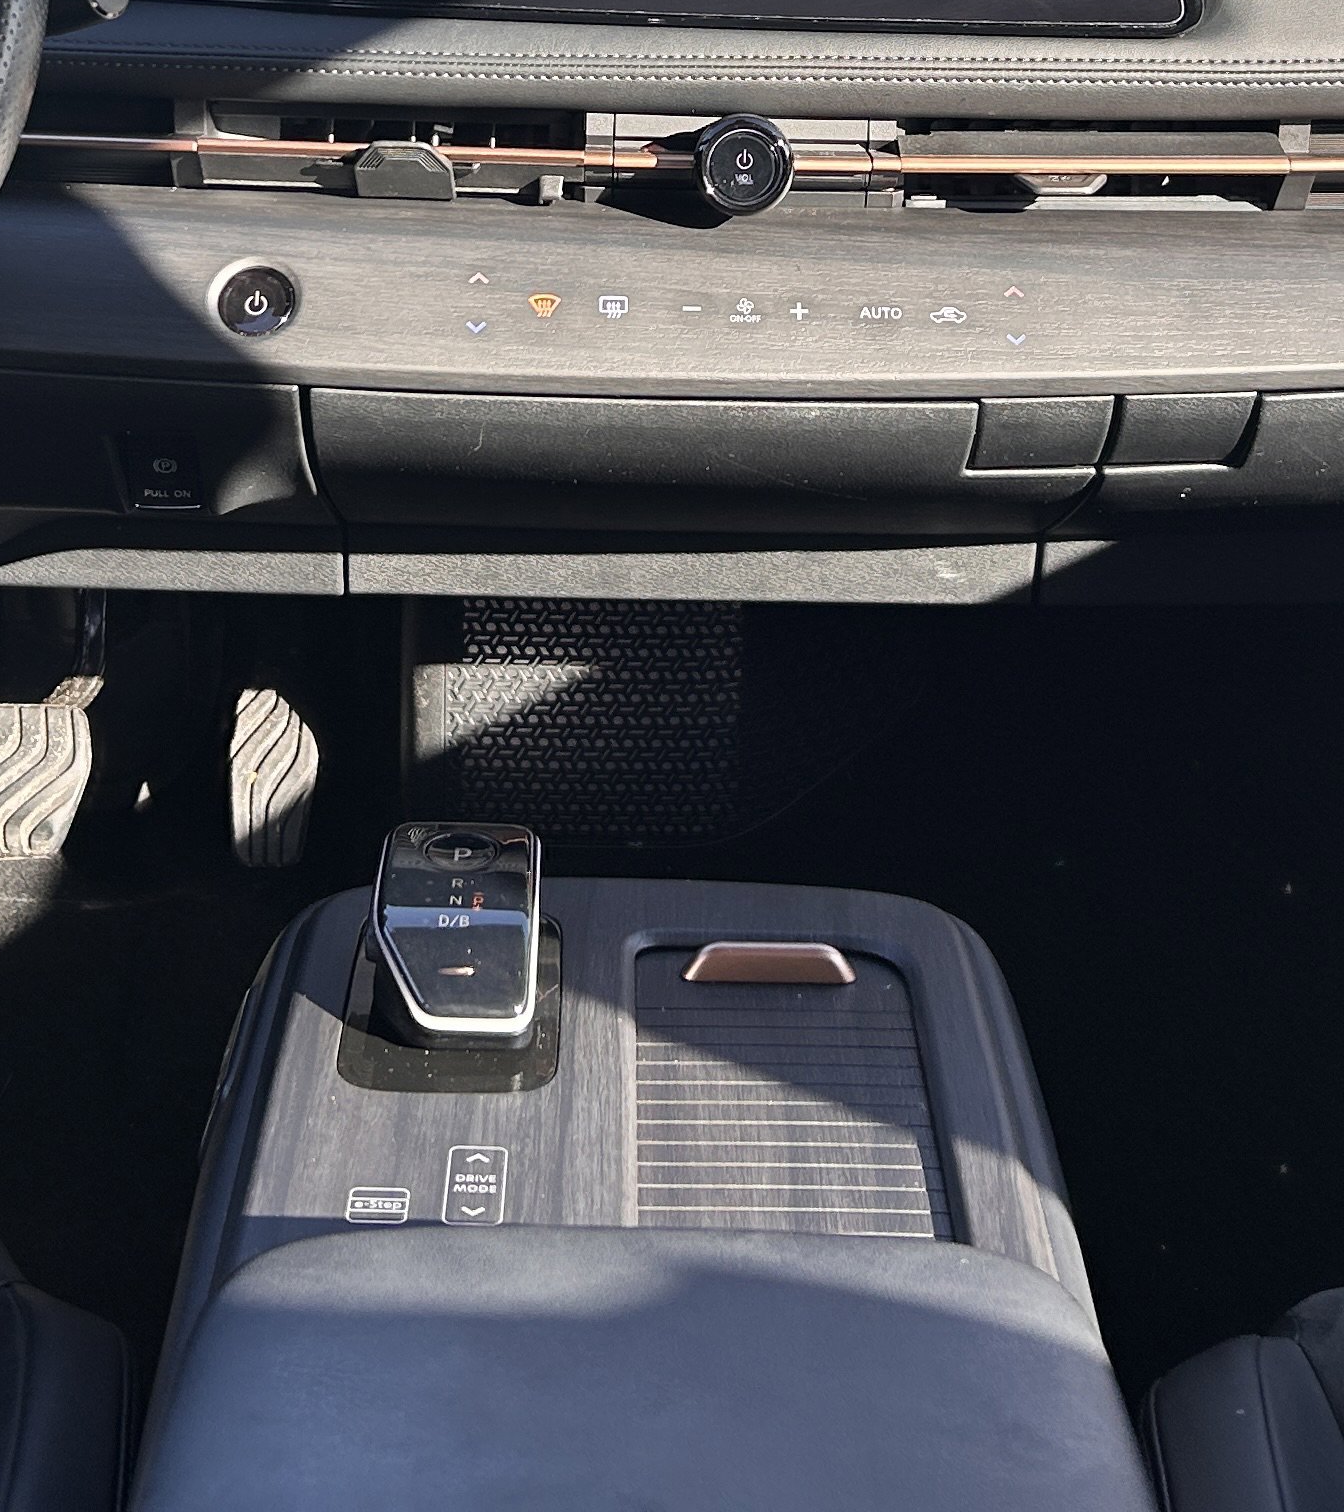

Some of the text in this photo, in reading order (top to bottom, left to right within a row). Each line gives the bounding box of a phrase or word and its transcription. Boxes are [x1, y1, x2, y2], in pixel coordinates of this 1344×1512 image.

[734, 173, 754, 183] VOL
[859, 306, 903, 320] AUTO
[144, 489, 191, 498] PULL ON
[453, 847, 473, 861] P
[451, 878, 463, 889] R
[449, 895, 462, 905] N
[438, 914, 470, 928] D/B
[455, 1174, 497, 1184] DRIVE
[452, 1184, 497, 1194] MODE
[354, 1199, 403, 1211] e-Step
